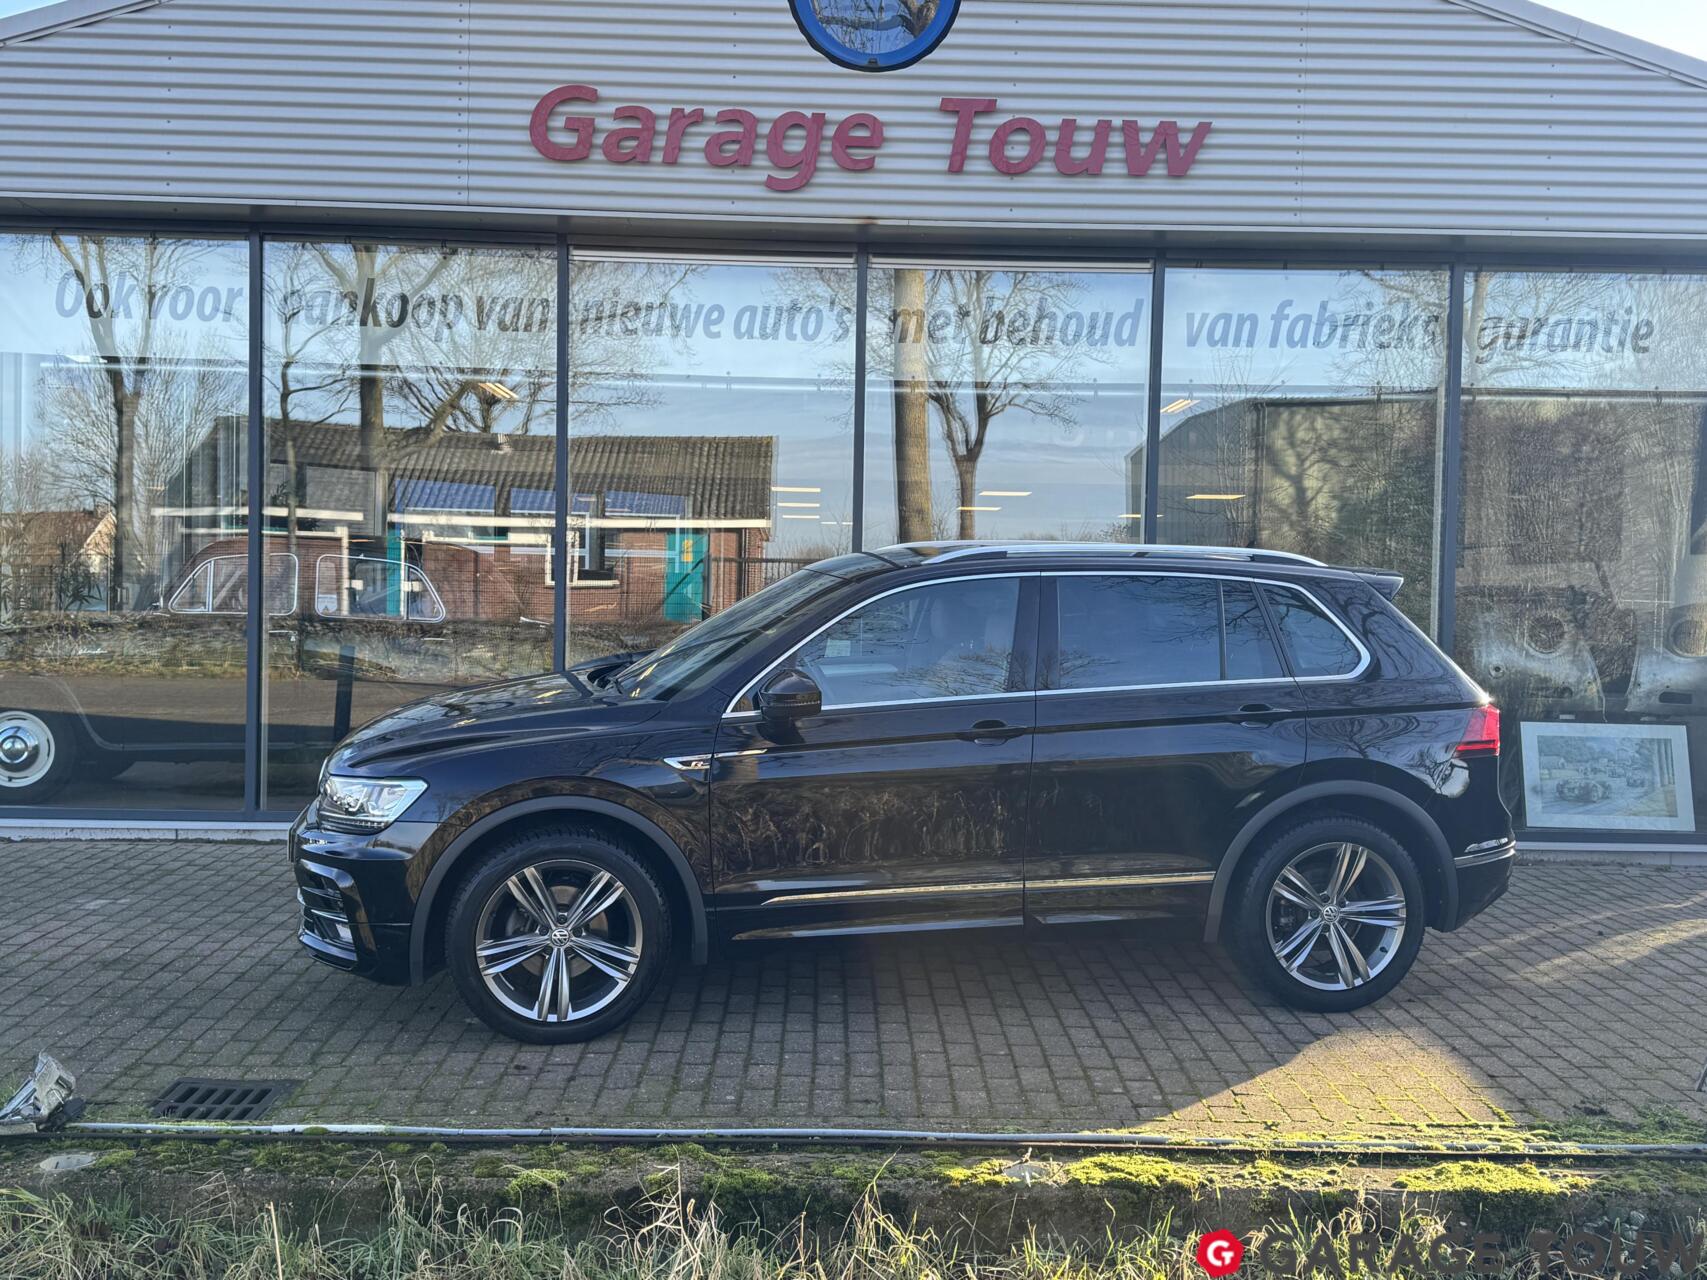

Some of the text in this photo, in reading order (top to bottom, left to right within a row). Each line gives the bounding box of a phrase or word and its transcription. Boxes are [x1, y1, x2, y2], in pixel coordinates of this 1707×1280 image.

[529, 84, 1213, 192] Garage Touw
[55, 269, 137, 319] Ook
[148, 284, 244, 323] voor
[277, 278, 463, 342] ankoop
[476, 295, 551, 333] van
[579, 287, 726, 339] nieuwe
[733, 293, 850, 343] auto's
[979, 296, 1145, 347] behoud
[1186, 311, 1259, 349] van
[1476, 305, 1655, 364] garantie
